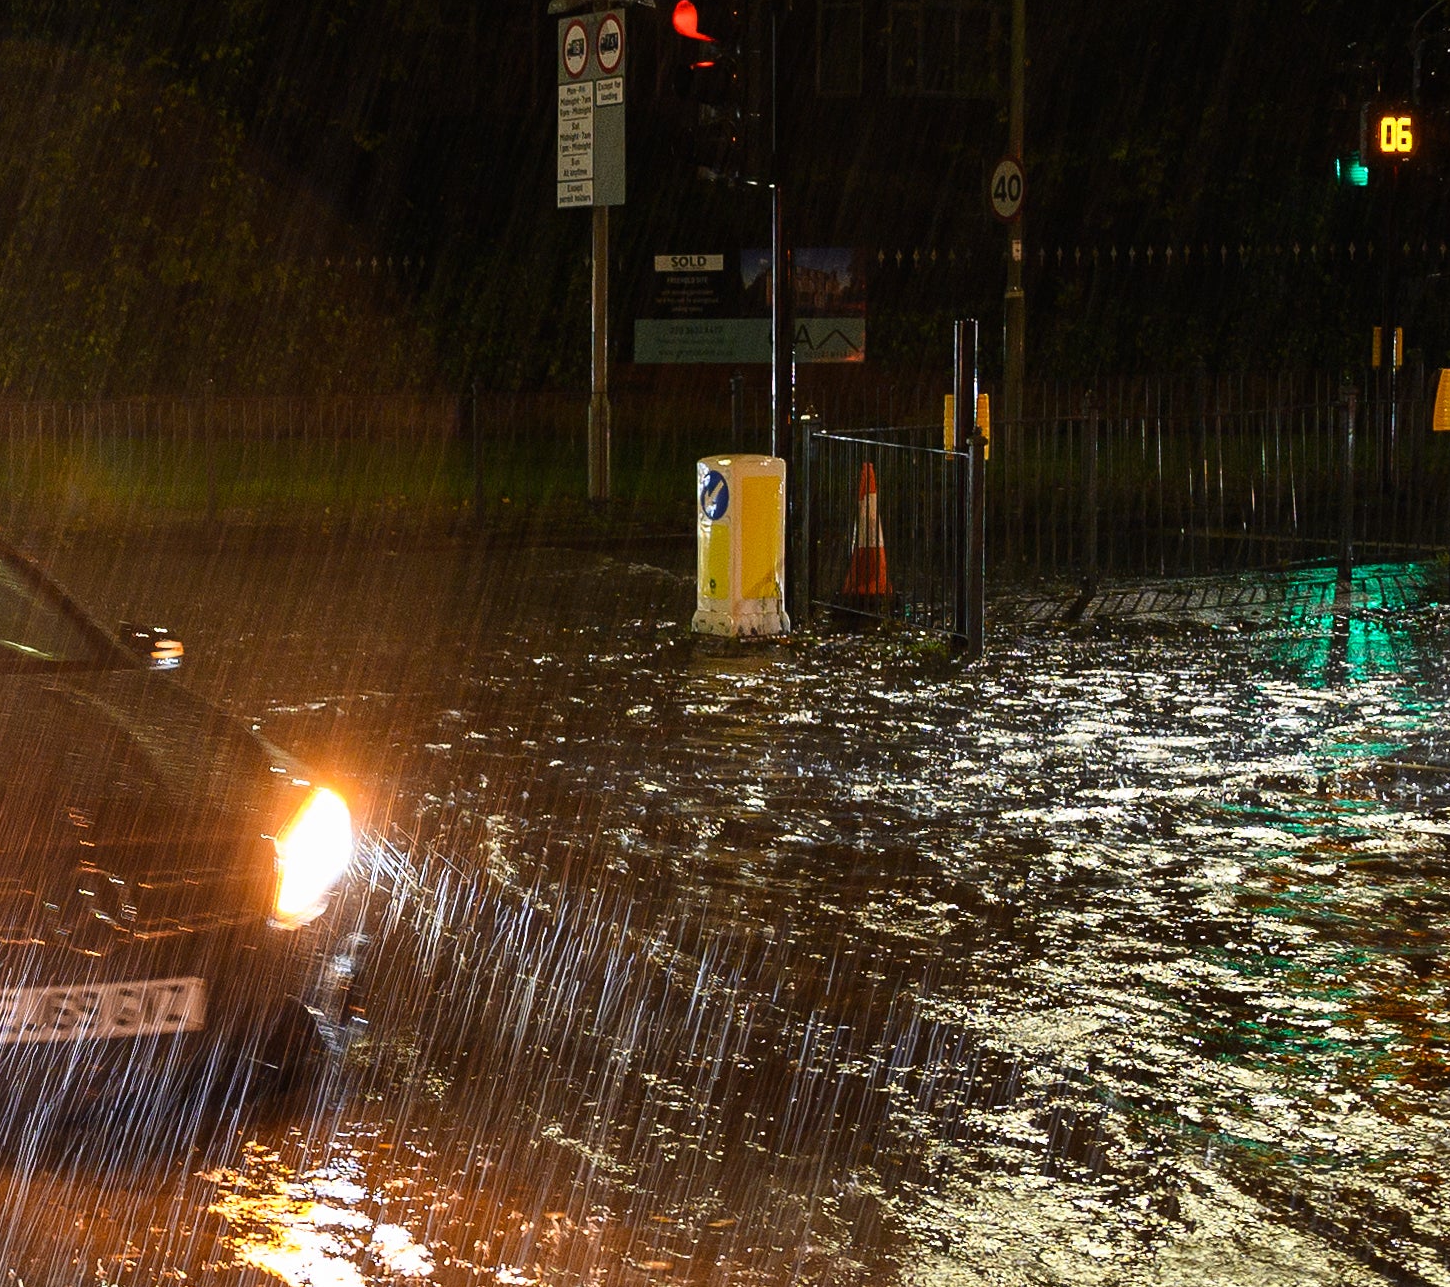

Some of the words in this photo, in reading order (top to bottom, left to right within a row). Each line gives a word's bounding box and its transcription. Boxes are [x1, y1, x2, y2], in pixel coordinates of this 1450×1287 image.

[1380, 117, 1413, 153] 06
[993, 175, 1021, 202] 40
[670, 256, 707, 268] SOLD
